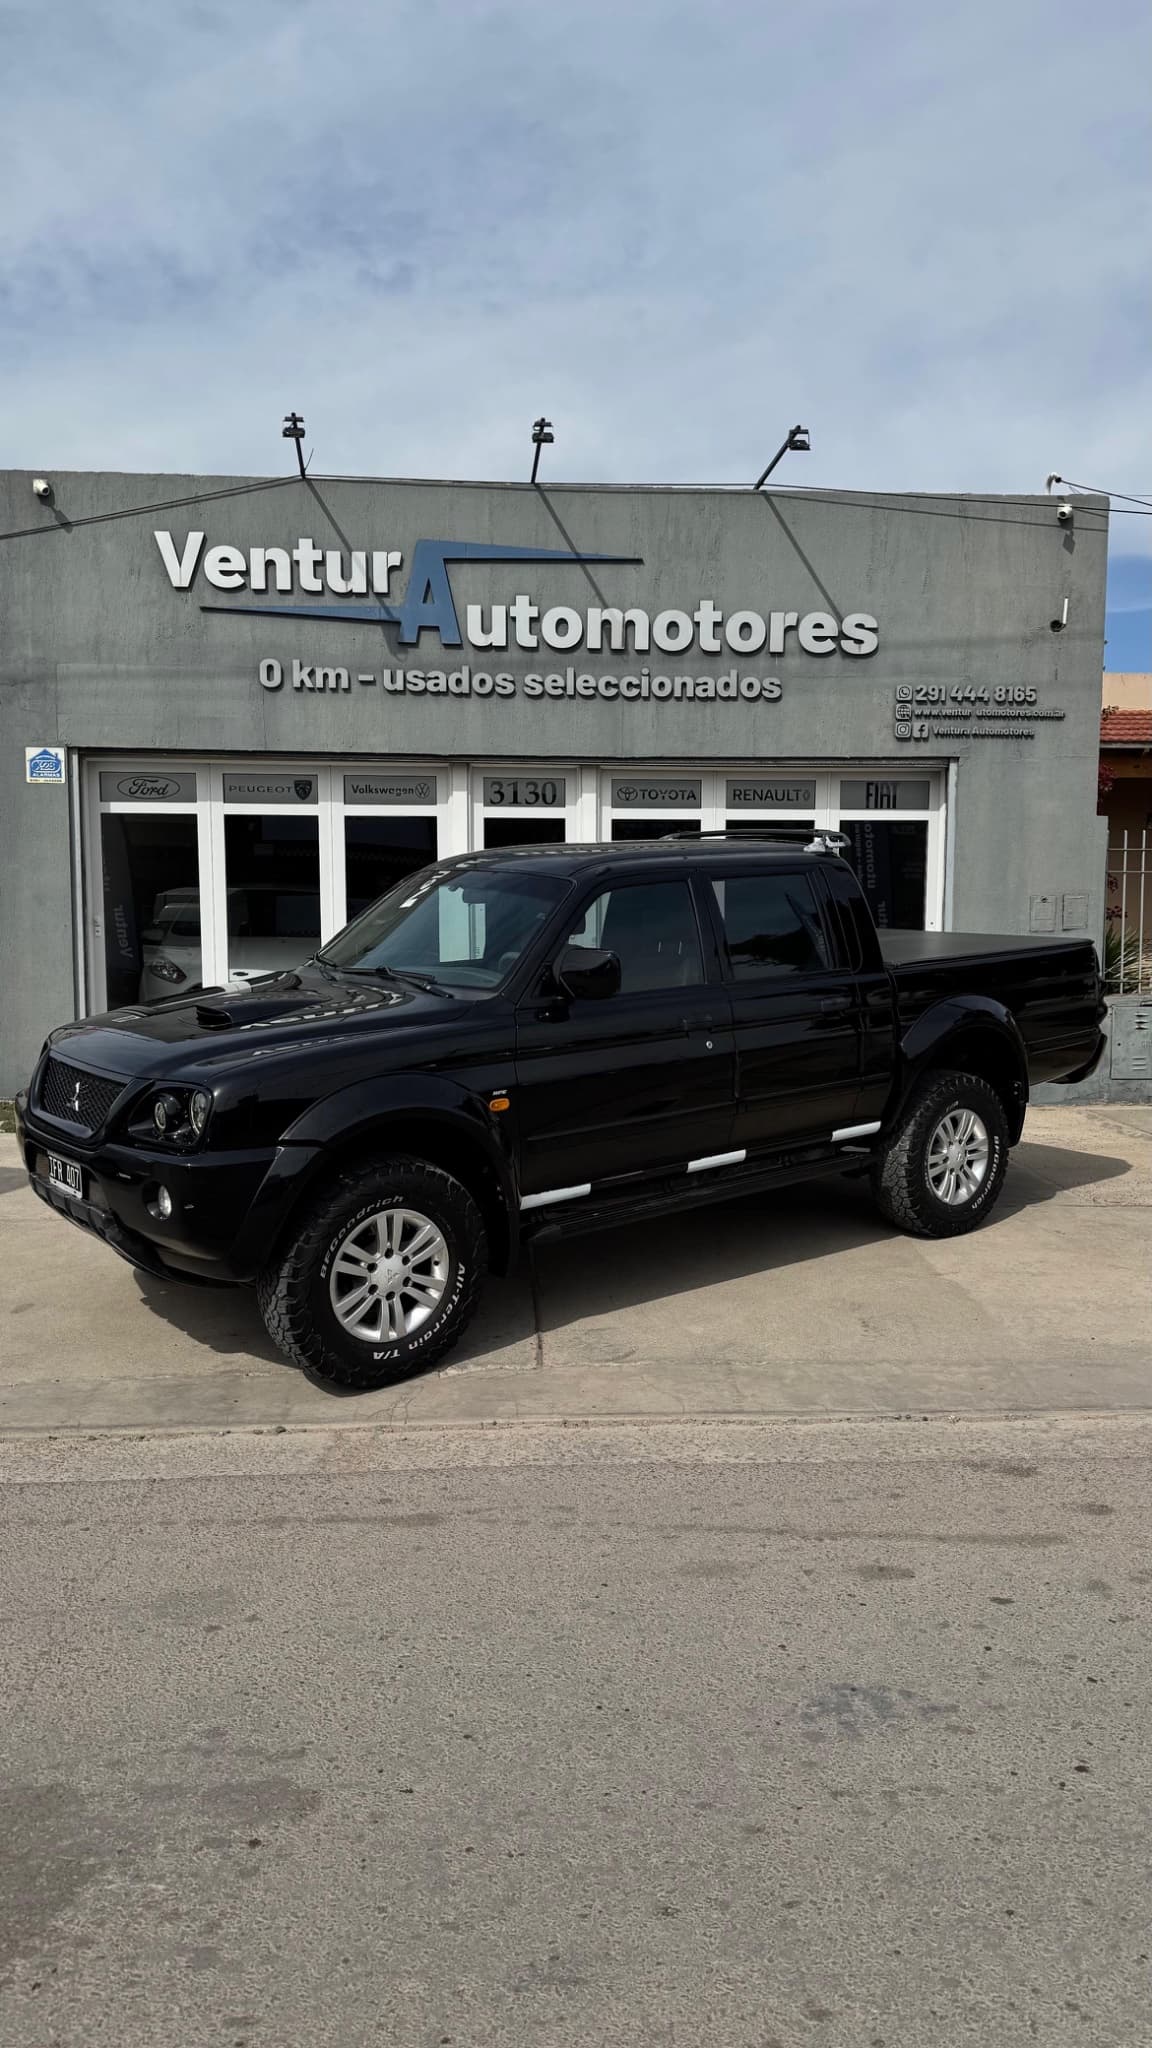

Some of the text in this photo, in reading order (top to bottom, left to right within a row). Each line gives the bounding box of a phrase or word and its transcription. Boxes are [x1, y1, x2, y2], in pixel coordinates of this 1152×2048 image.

[259, 658, 283, 689] 0
[293, 659, 350, 690] km
[383, 665, 516, 695] usados
[524, 667, 782, 699] seleccionados
[915, 685, 1037, 703] 291 444 8165
[933, 726, 1035, 737] Ventura Automotores
[128, 778, 169, 796] Ford
[228, 785, 293, 793] PEUGEOT
[351, 784, 414, 797] Volkswagen
[489, 781, 557, 806] 3130
[640, 789, 696, 801] TOYOTA
[733, 788, 803, 802] RENAULT
[865, 781, 898, 809] FIAT
[48, 1155, 79, 1190] IFR 407
[320, 1195, 404, 1279] BFGoodrich
[373, 1262, 466, 1360] All-Terrain T/A
